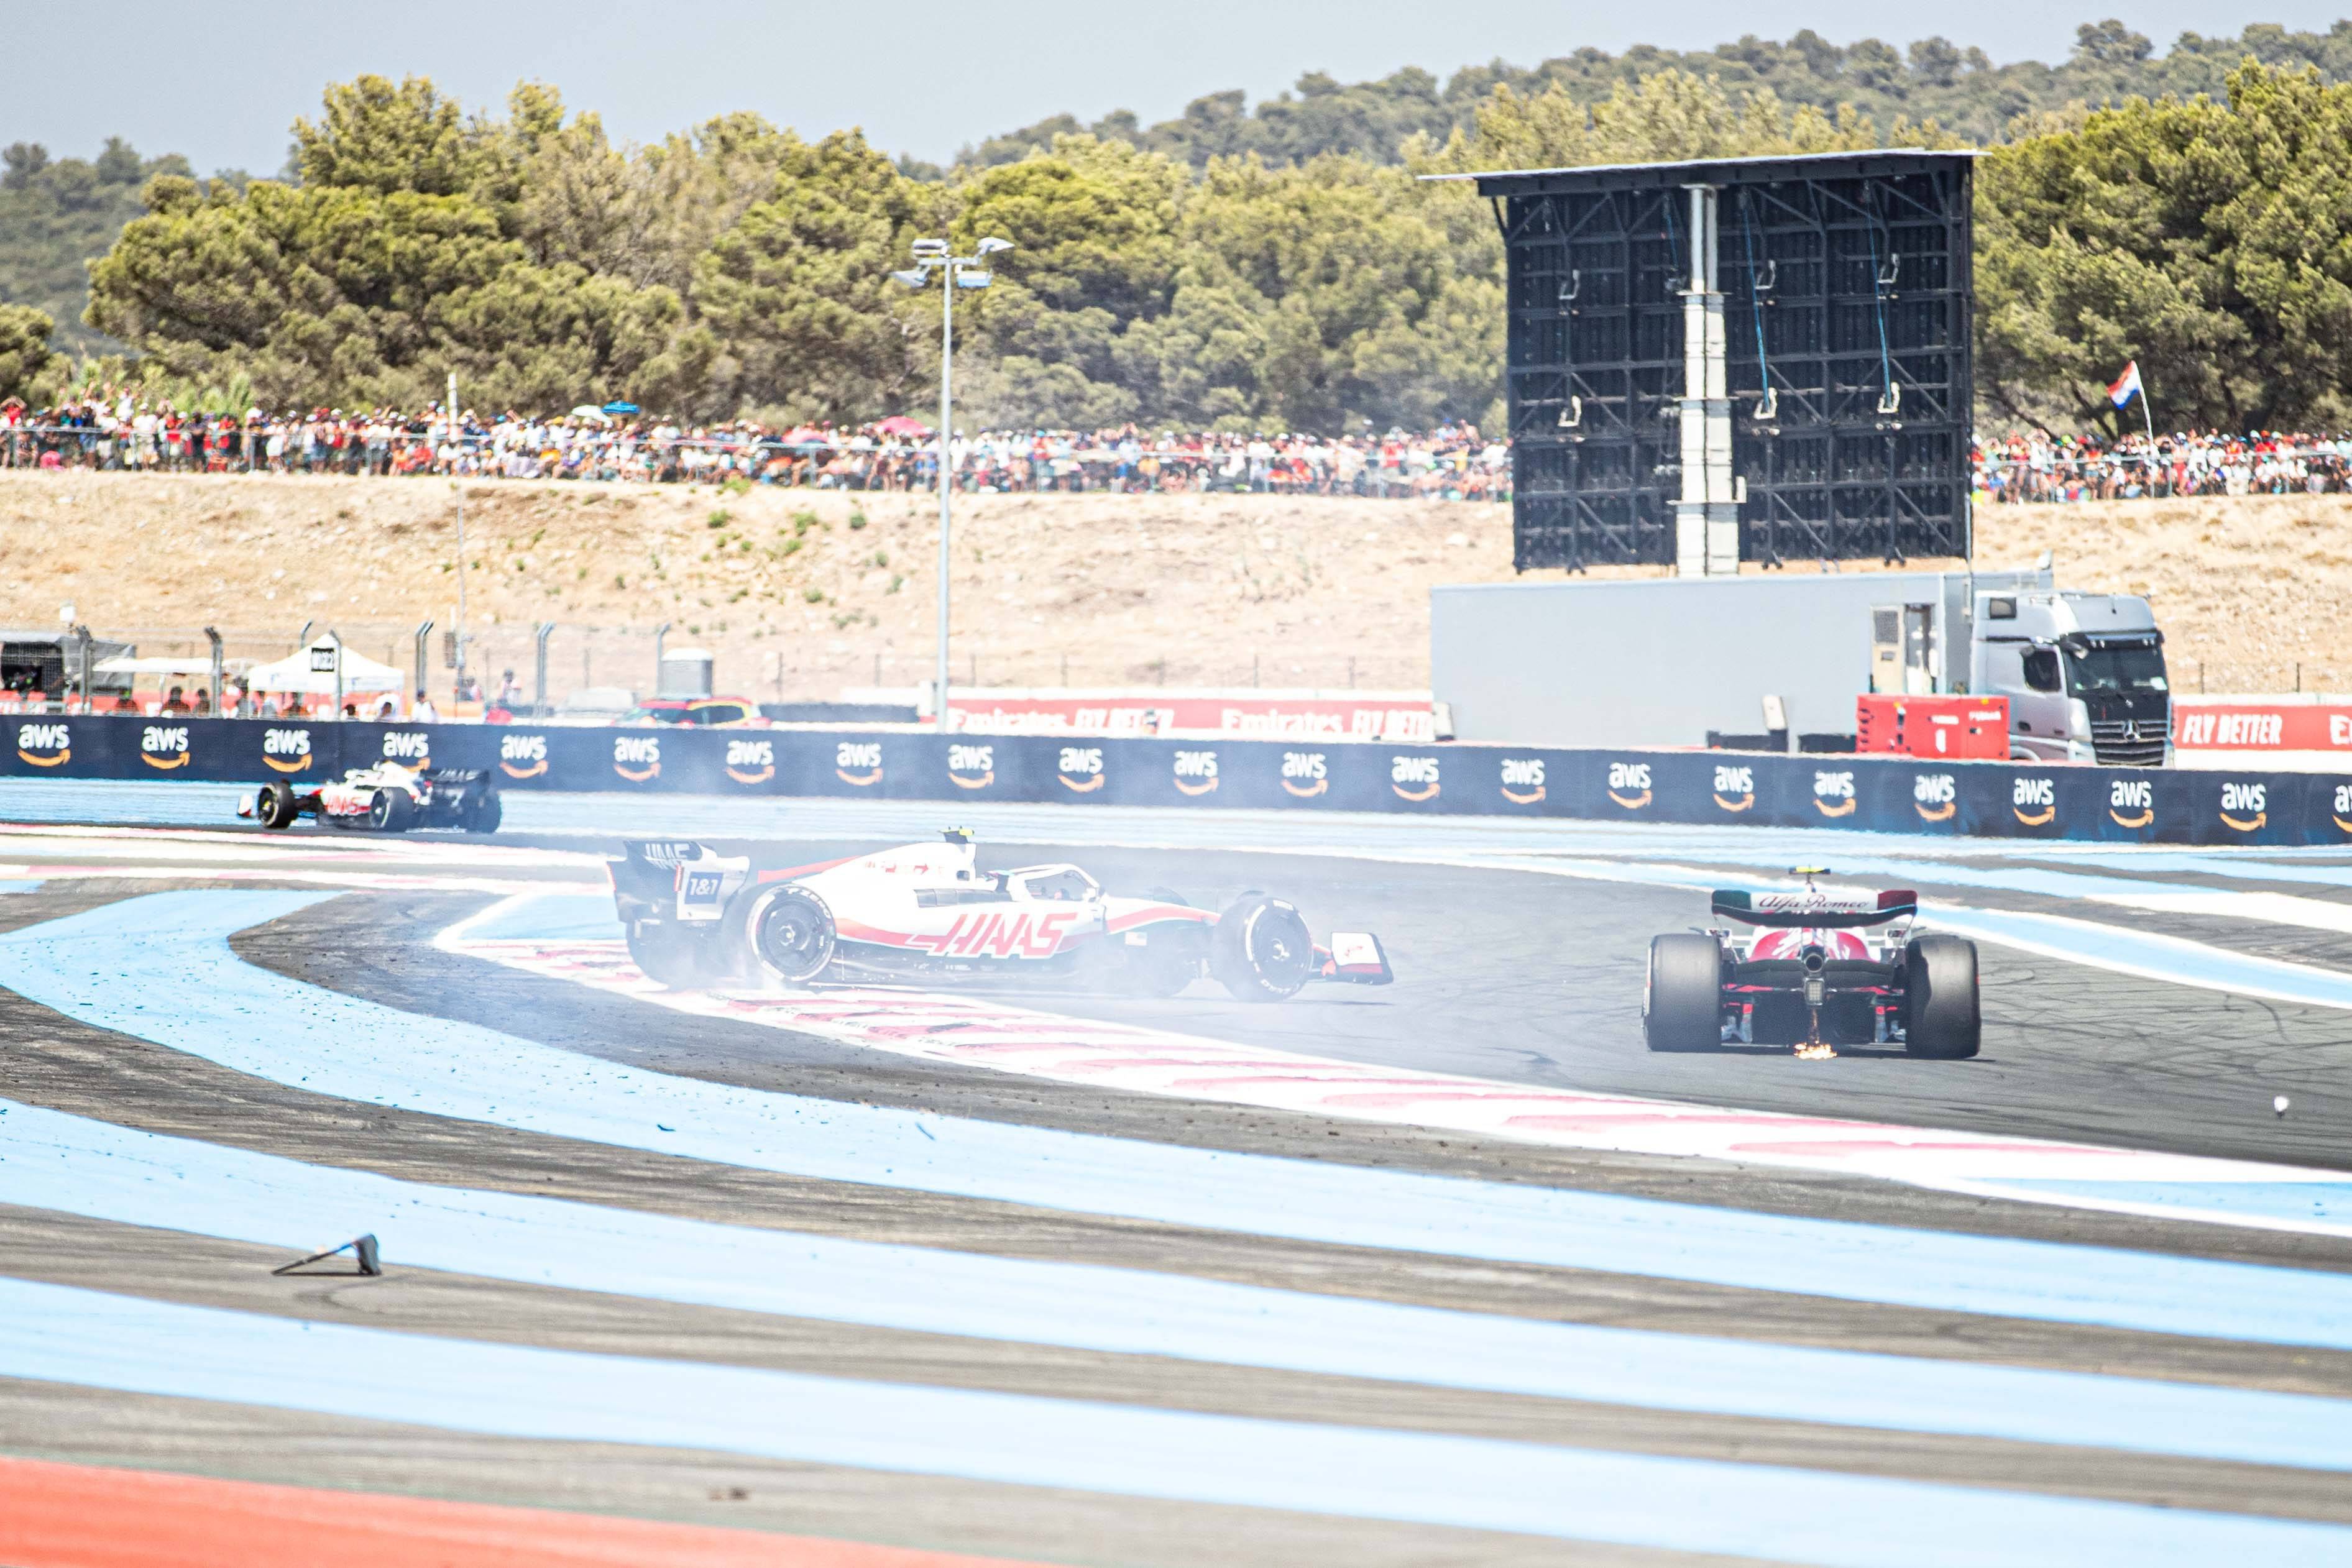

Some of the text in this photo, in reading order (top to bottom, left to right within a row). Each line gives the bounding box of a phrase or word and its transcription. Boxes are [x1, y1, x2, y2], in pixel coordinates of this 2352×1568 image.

[19, 724, 70, 749] aws
[142, 726, 188, 752] aws
[264, 728, 310, 755] aws
[2182, 714, 2283, 744] FLY BETTER
[383, 732, 429, 758] aws
[501, 735, 547, 762] aws
[614, 737, 660, 763] aws
[726, 740, 773, 767] aws
[837, 742, 881, 767] aws
[949, 745, 993, 771] aws
[1059, 748, 1103, 774] aws
[1174, 751, 1218, 777] aws
[1282, 752, 1326, 779] aws
[1392, 756, 1439, 782] aws
[1501, 759, 1545, 786] aws
[1609, 763, 1651, 789] aws
[1714, 766, 1753, 792] aws
[1814, 771, 1854, 798] aws
[1914, 775, 1955, 802] aws
[2013, 778, 2054, 805] aws
[2111, 781, 2152, 807] aws
[2221, 782, 2266, 809] aws
[2335, 786, 2352, 813] a
[689, 878, 719, 896] 1&1
[1758, 894, 1869, 912] Alfa Romeo
[911, 912, 1078, 956] HAAS
